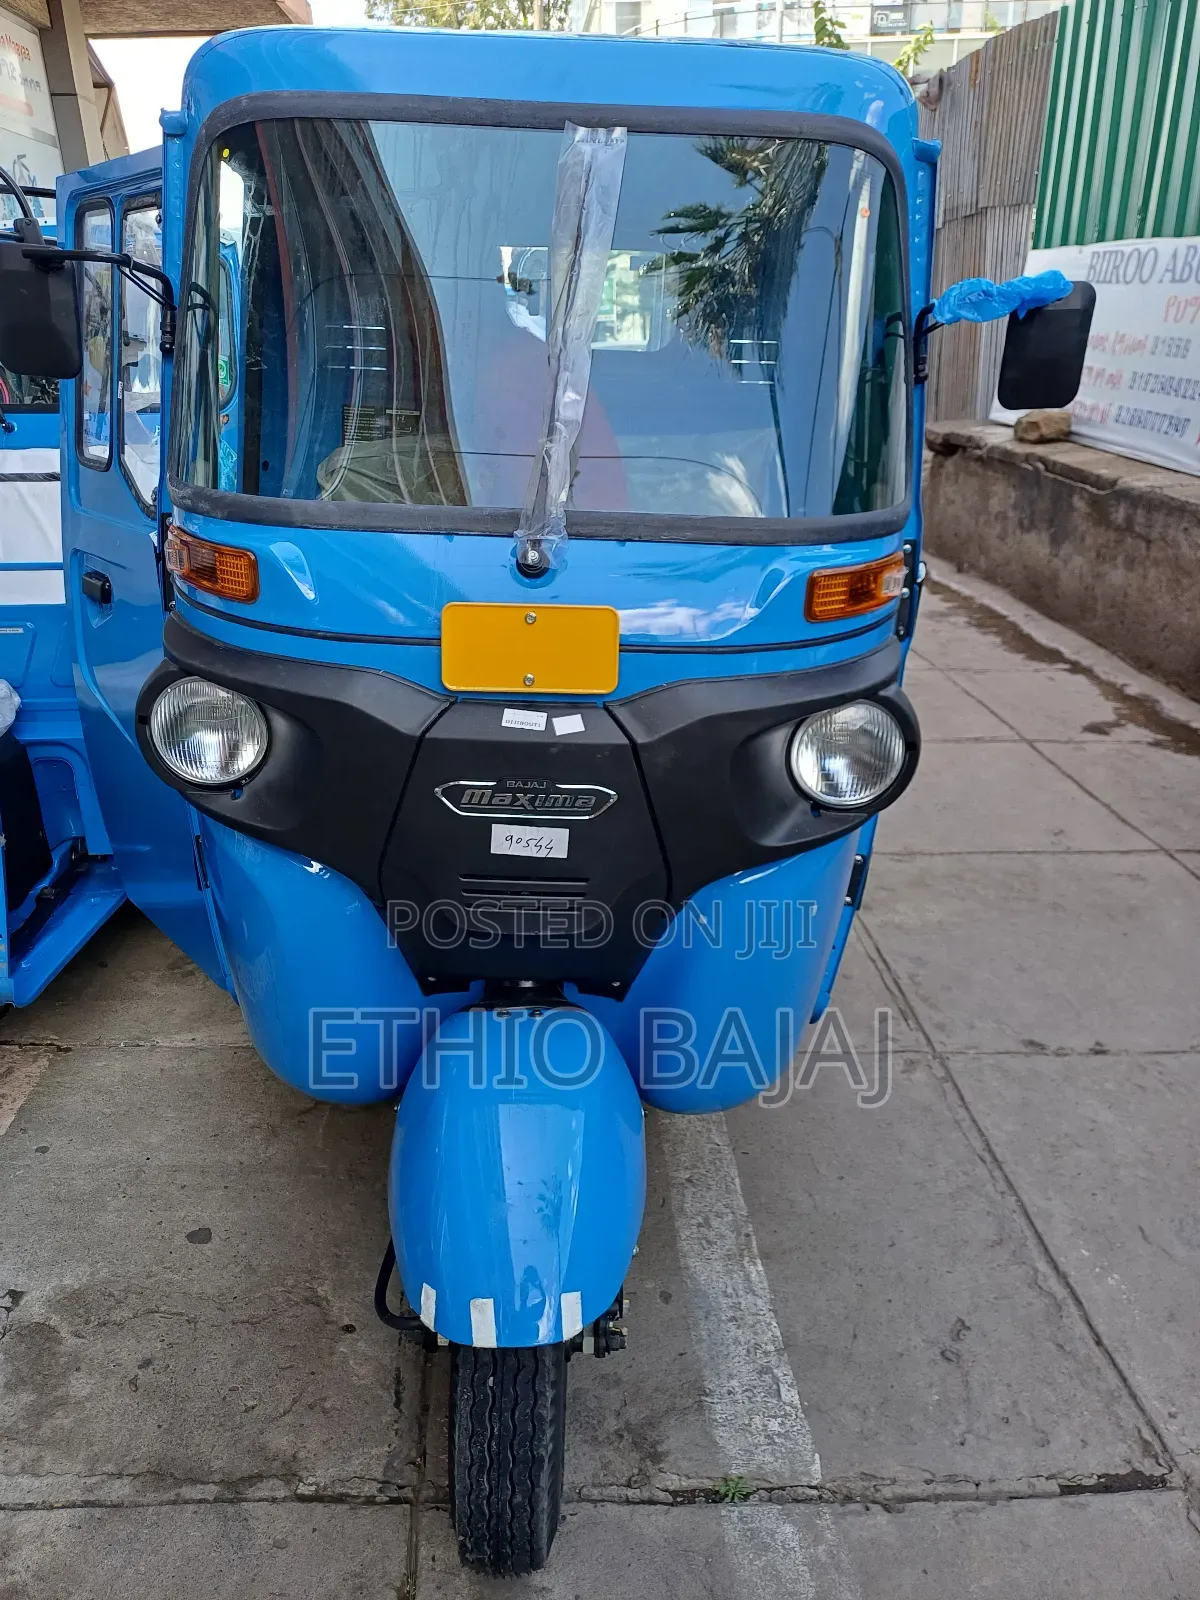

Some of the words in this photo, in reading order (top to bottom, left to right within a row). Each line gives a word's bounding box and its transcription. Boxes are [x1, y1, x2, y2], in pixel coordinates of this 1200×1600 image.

[1087, 248, 1158, 284] BIIROO
[506, 780, 547, 789] BAJAJ
[505, 834, 555, 858] 90544
